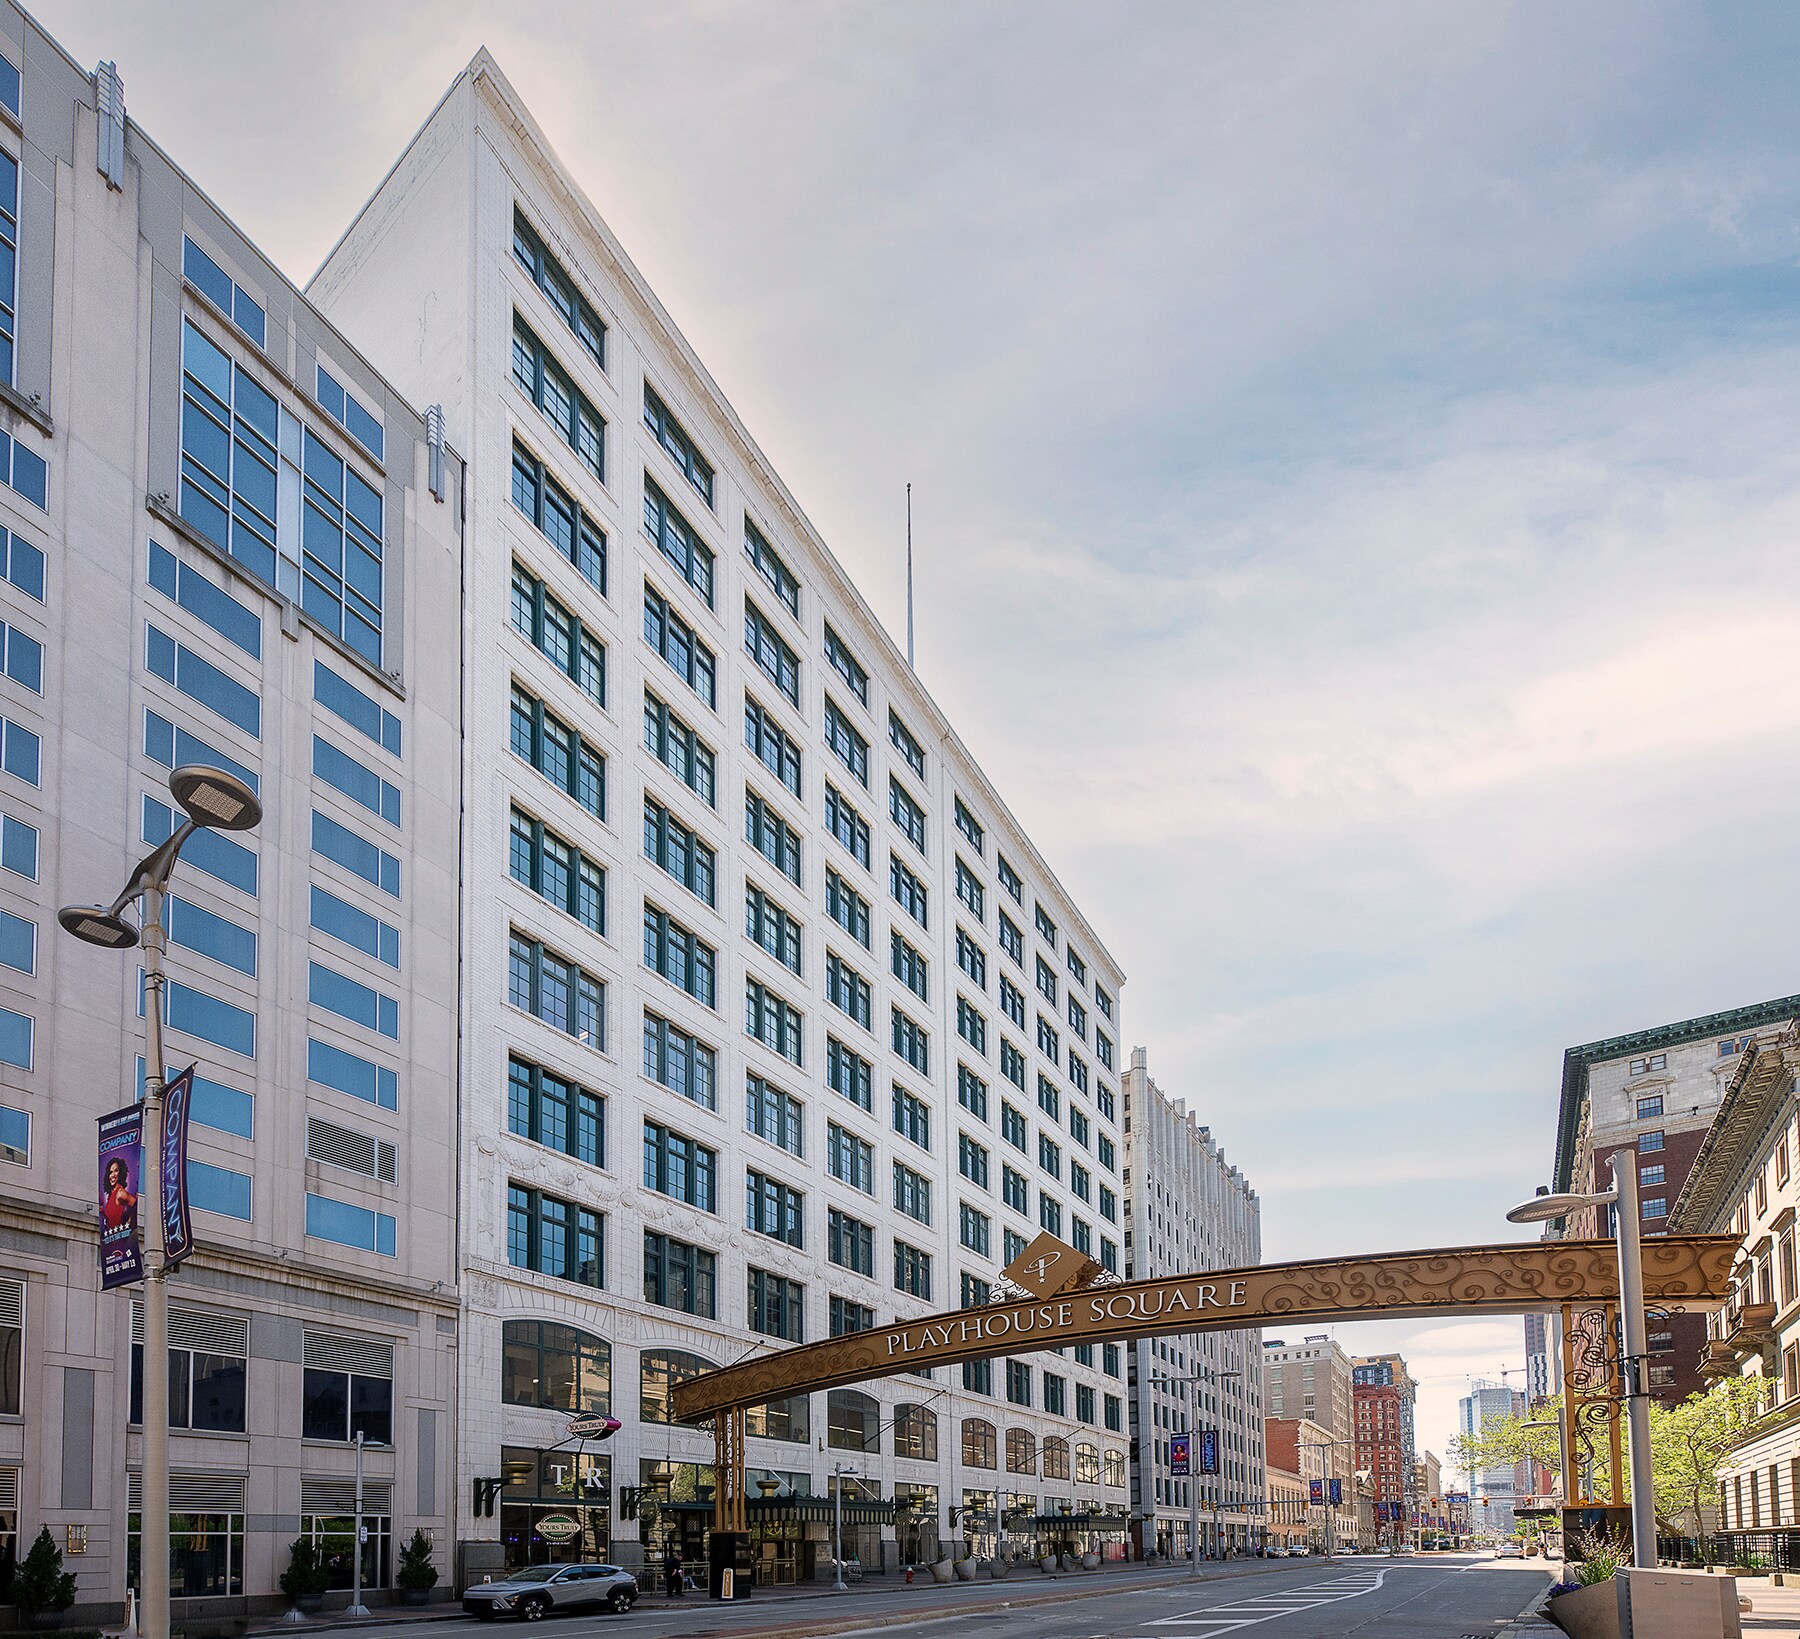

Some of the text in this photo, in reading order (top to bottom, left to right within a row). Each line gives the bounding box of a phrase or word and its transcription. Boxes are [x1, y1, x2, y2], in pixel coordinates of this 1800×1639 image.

[100, 1131, 138, 1152] COMPANY
[166, 1090, 183, 1244] COMPANY
[886, 1281, 1247, 1356] PLAYHOUSE SQUARE
[569, 1421, 606, 1431] YOURS TRULY
[1204, 1433, 1214, 1471] COMPANY
